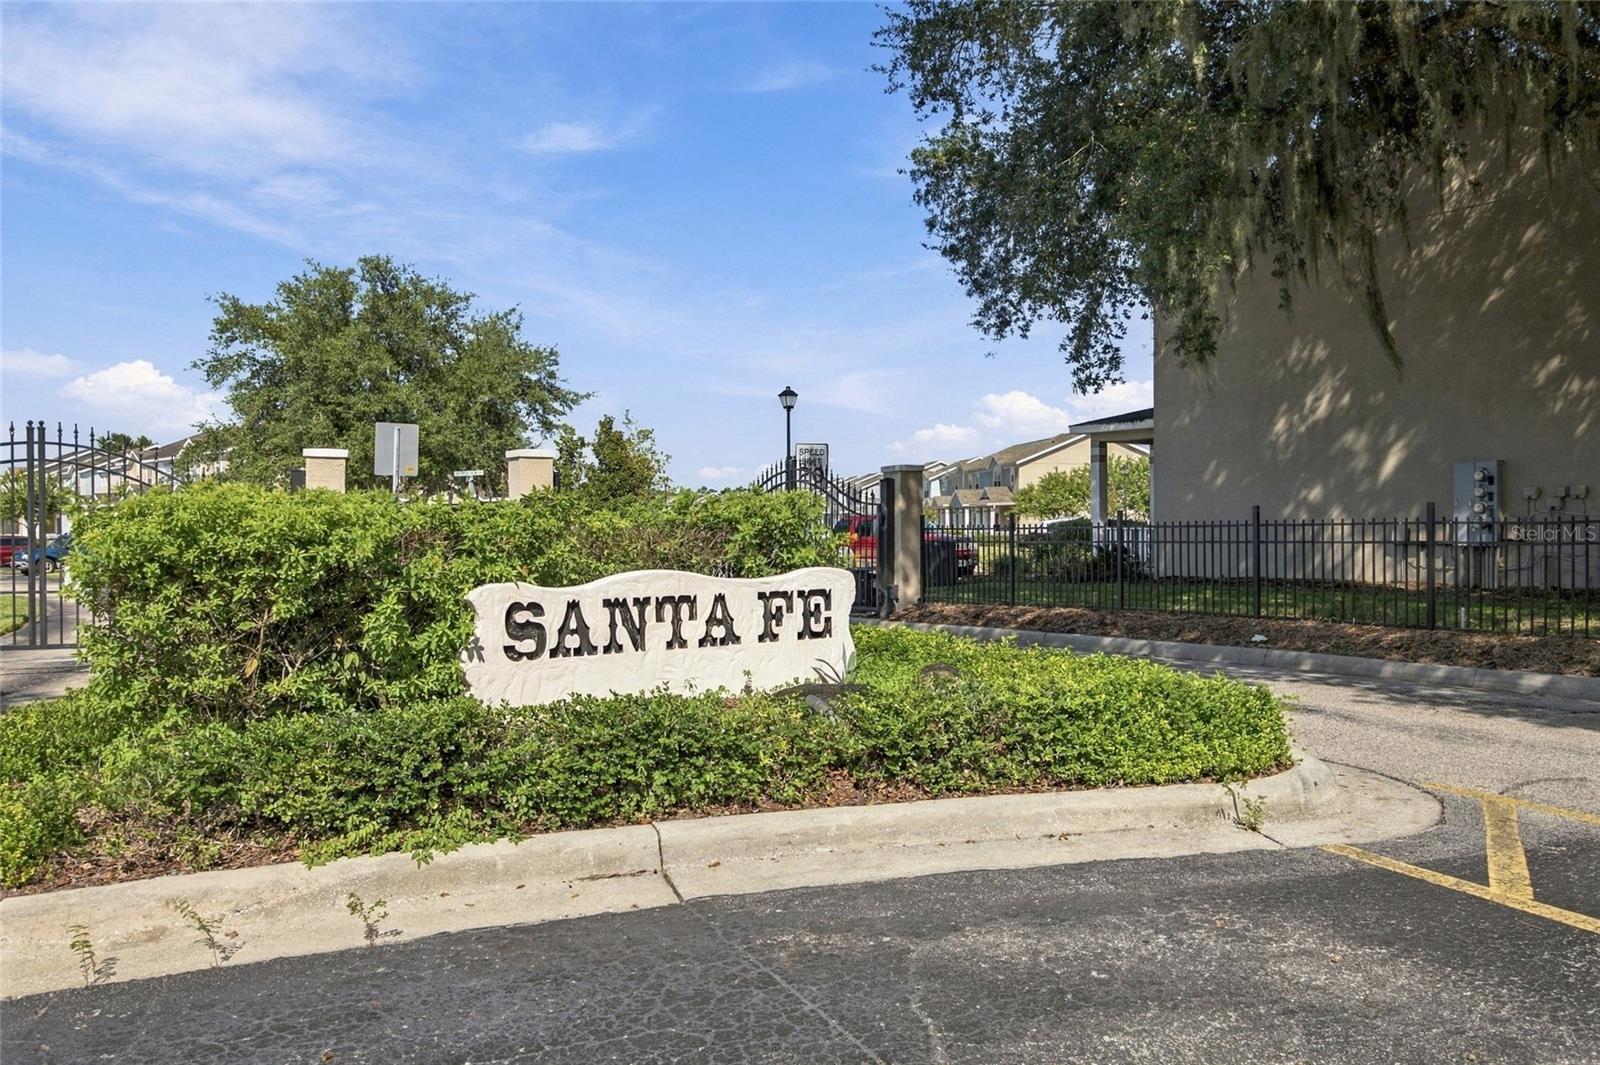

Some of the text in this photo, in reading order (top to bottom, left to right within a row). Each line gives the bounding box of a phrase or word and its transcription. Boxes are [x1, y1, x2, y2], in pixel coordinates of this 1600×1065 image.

[799, 448, 825, 456] SPEED
[502, 588, 833, 662] SANTA FE
